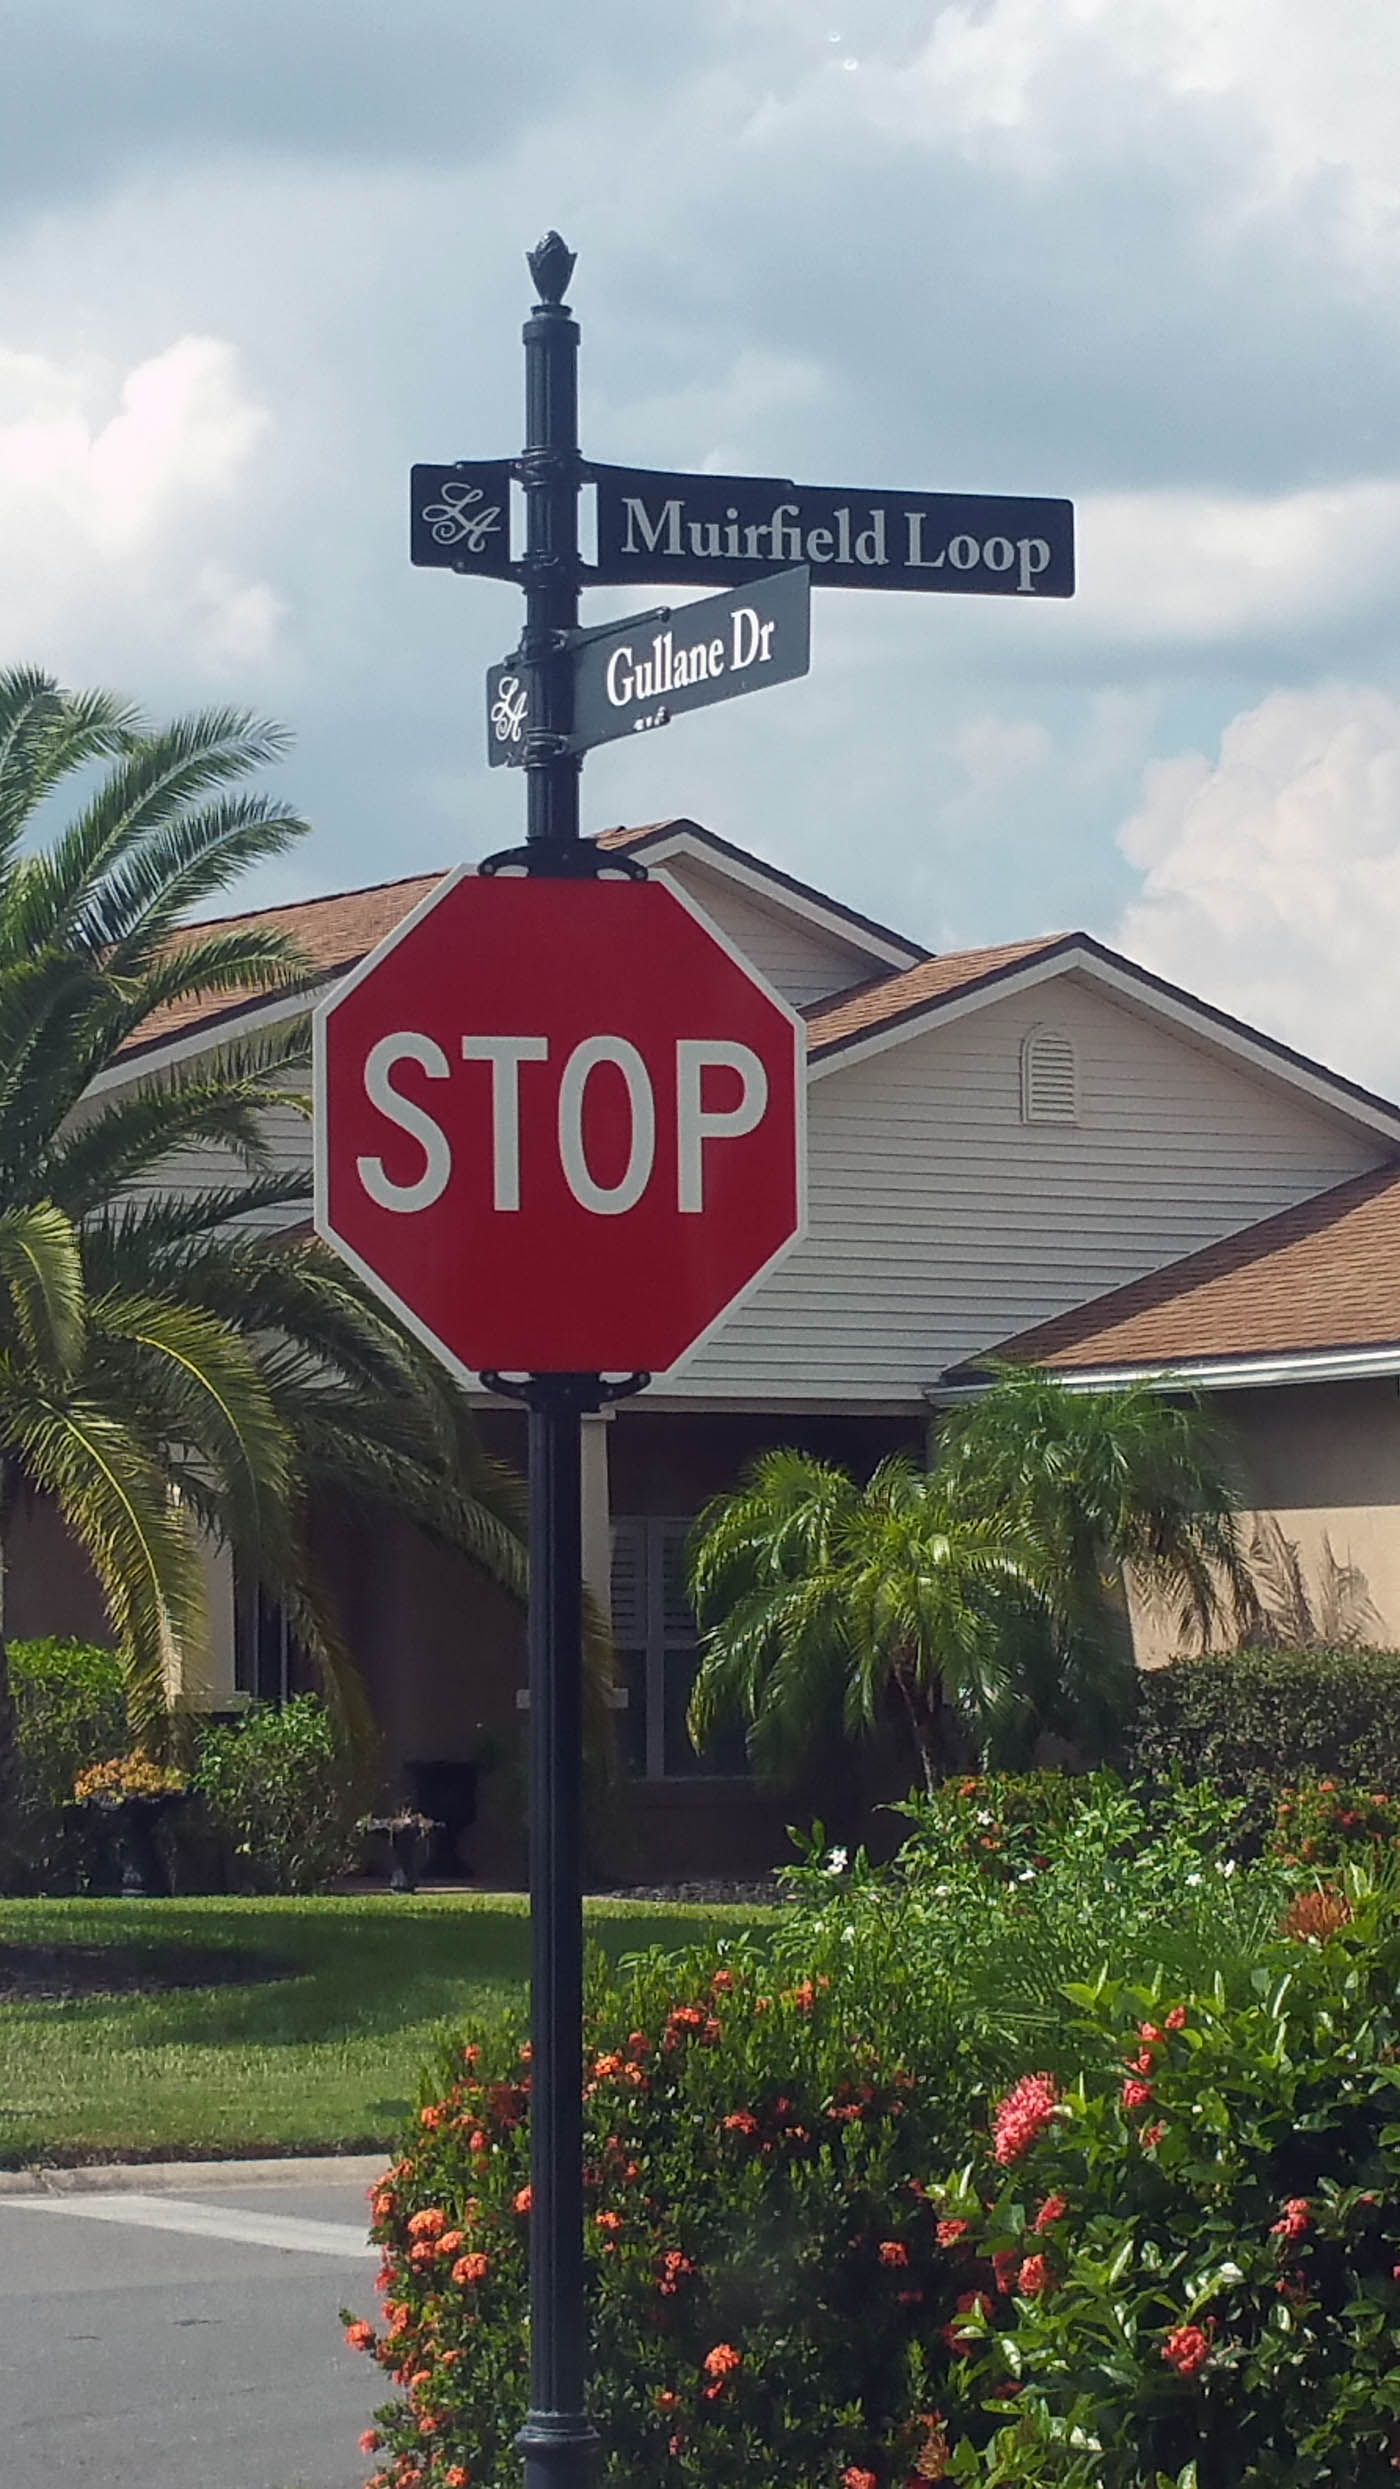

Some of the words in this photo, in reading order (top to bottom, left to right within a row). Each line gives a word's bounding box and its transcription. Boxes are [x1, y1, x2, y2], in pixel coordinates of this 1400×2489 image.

[620, 497, 889, 566] Muirfield
[903, 512, 1052, 591] Loop
[606, 631, 725, 706] Gullane
[729, 607, 776, 669] Dr
[356, 1031, 768, 1215] STOP
